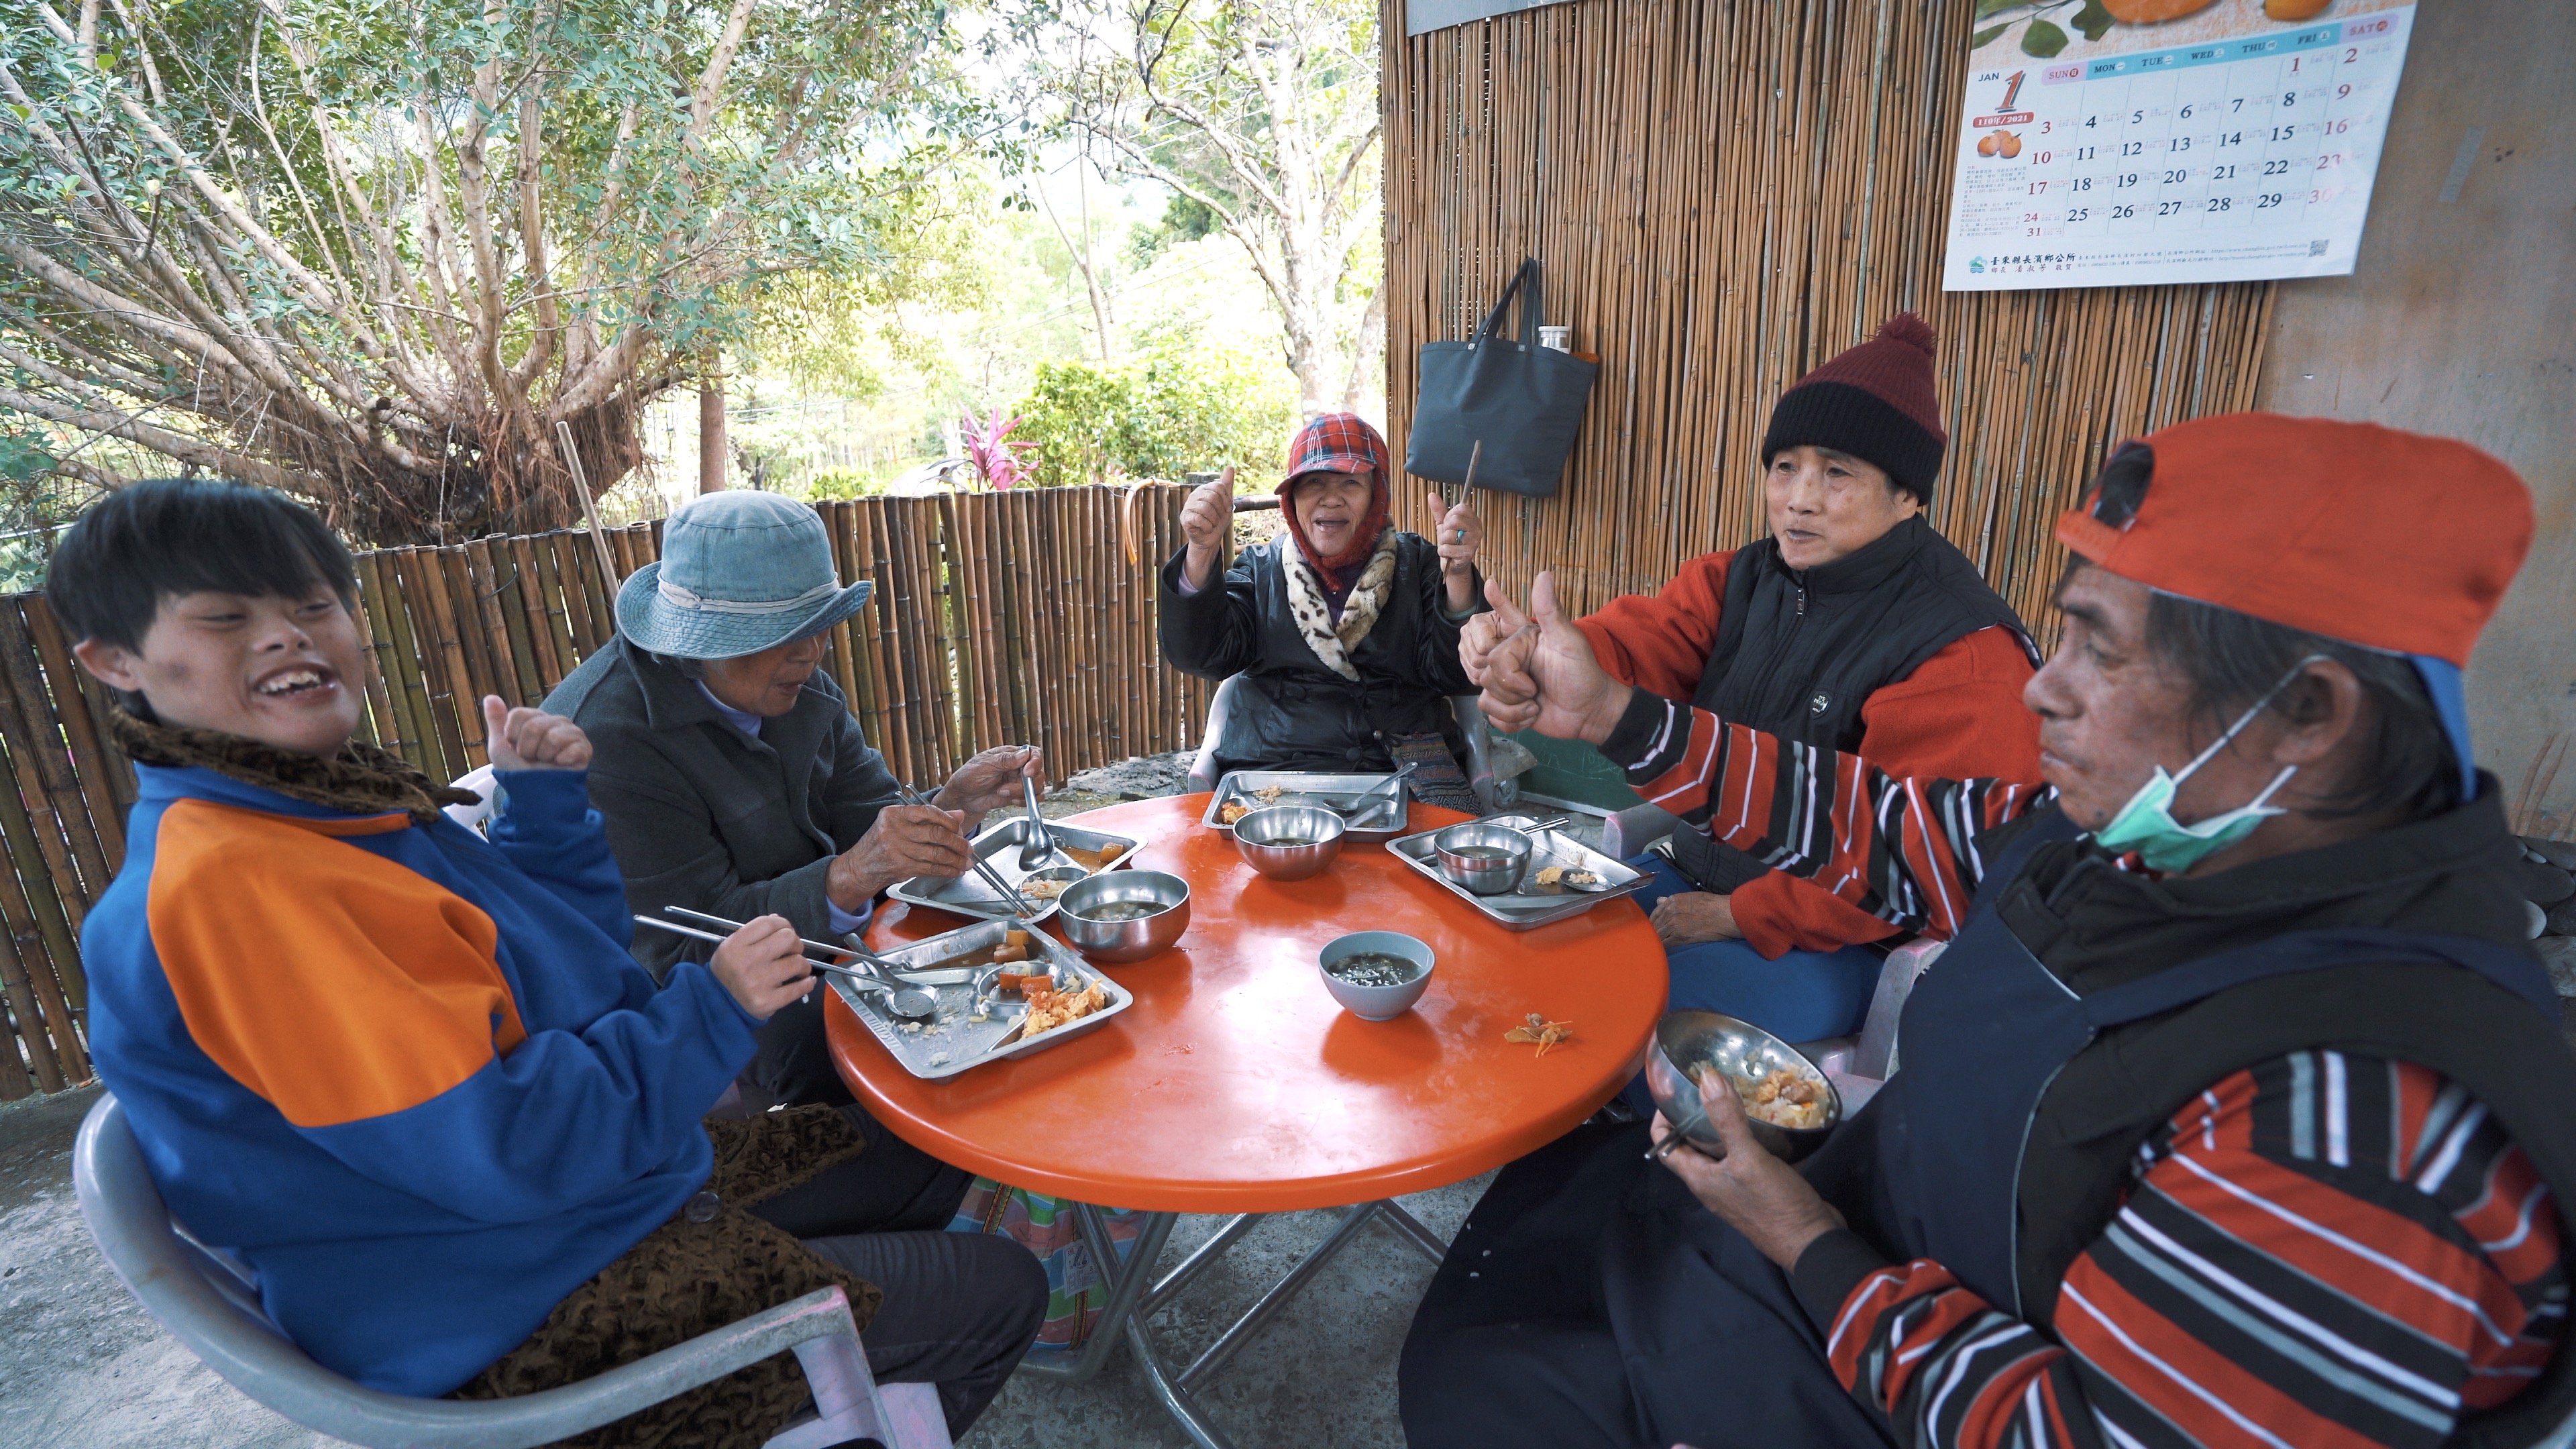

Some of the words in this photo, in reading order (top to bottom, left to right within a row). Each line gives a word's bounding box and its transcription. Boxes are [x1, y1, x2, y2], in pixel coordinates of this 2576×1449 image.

[2049, 70, 2069, 79] SUN
[2094, 63, 2116, 74] MON
[2141, 57, 2163, 66] TUE
[2191, 51, 2214, 60] WED
[2242, 42, 2266, 53] THU
[2298, 34, 2317, 45] FRI
[2349, 23, 2376, 35] SAT
[2292, 57, 2300, 72] 1
[2343, 48, 2358, 64] 2
[1978, 72, 2000, 82] JAN
[1994, 70, 2026, 113] 1
[2041, 121, 2051, 134] 3
[2085, 115, 2097, 129] 4
[2131, 110, 2145, 124] 5
[2180, 105, 2193, 119] 6
[2232, 98, 2244, 113] 7
[2284, 92, 2296, 107] 8
[2337, 84, 2351, 100] 9
[2032, 151, 2051, 165] 10
[2077, 146, 2095, 160] 11
[2122, 142, 2143, 156] 12
[2169, 137, 2191, 152] 13
[2218, 131, 2242, 147] 14
[2271, 125, 2295, 142] 15
[2324, 118, 2349, 135] 16
[2028, 181, 2047, 195] 17
[2072, 177, 2092, 192] 18
[2116, 173, 2138, 188] 19
[2163, 169, 2187, 184] 20
[2213, 164, 2235, 180] 21
[2263, 160, 2288, 175] 22
[2023, 213, 2039, 223] 24
[2067, 208, 2089, 222] 25
[2111, 205, 2135, 219] 26
[2158, 201, 2182, 215] 27
[2206, 197, 2231, 212] 28
[2257, 193, 2282, 209] 29
[2027, 227, 2041, 237] 31
[1990, 252, 2077, 266] 臺東縣長濱鄉公所
